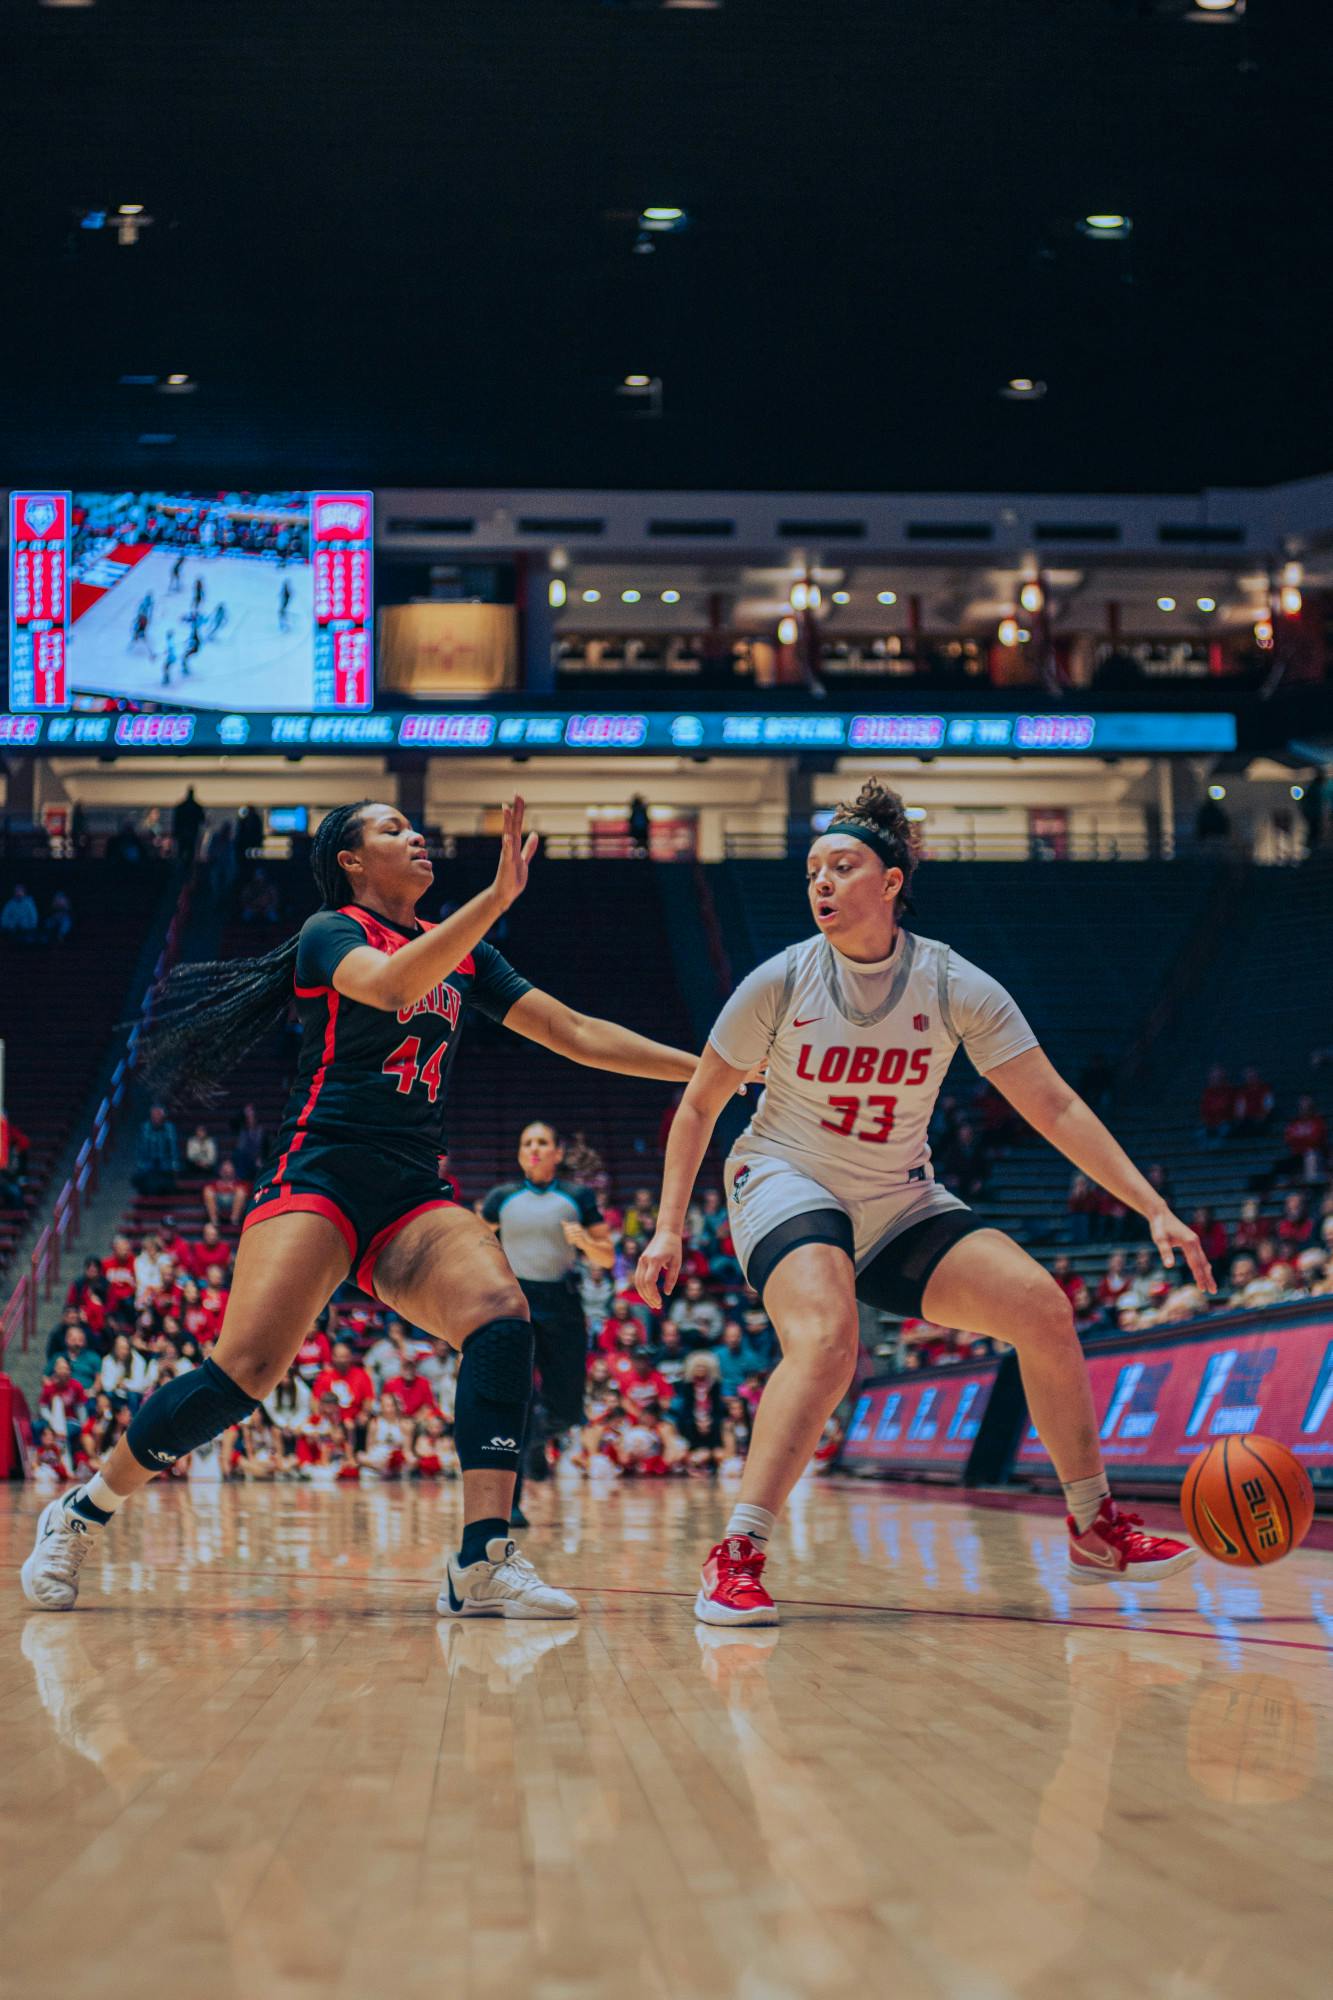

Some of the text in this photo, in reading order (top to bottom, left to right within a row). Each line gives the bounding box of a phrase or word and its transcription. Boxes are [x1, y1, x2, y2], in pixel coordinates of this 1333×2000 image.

[115, 714, 196, 745] LOBOS
[382, 1035, 448, 1103] 44
[796, 1044, 932, 1086] LOBOS
[820, 1095, 898, 1143] 33
[1241, 1477, 1279, 1549] ELITE
